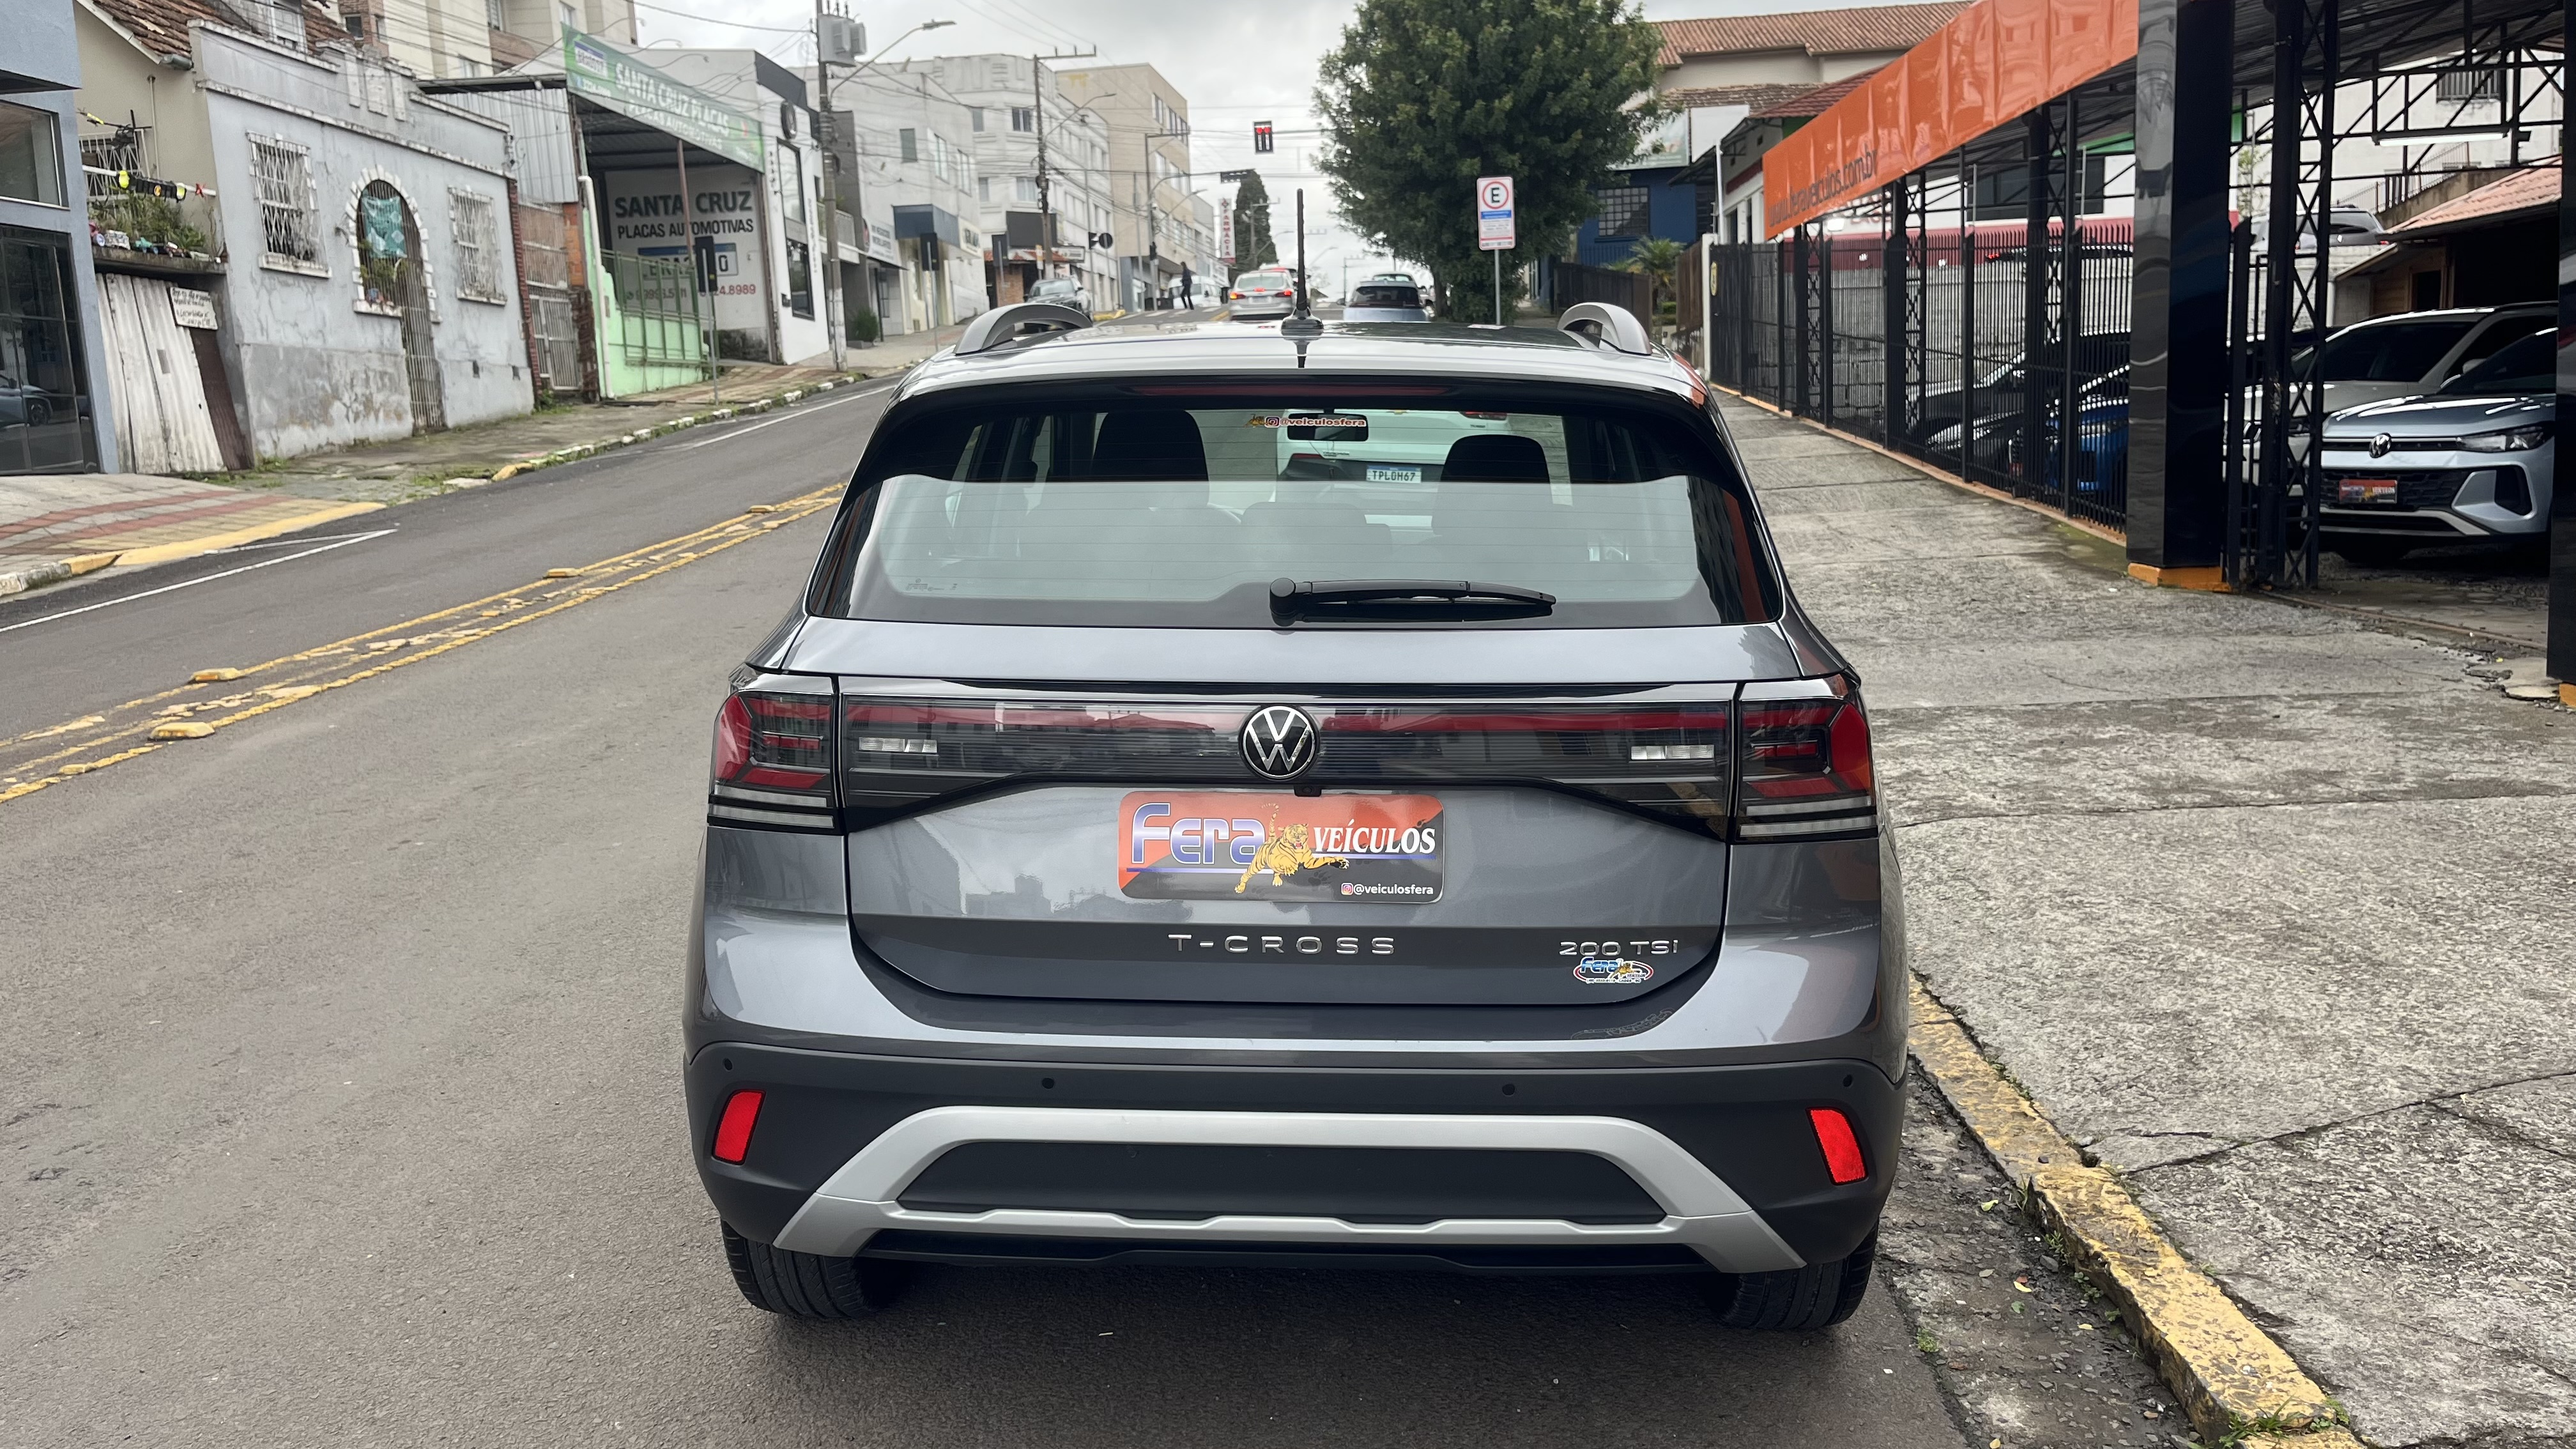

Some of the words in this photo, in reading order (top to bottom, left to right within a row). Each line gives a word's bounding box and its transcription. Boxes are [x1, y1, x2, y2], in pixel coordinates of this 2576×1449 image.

[615, 63, 656, 105] SANTA
[658, 82, 689, 117] CRUZ
[615, 194, 685, 218] SANTA
[695, 190, 753, 214] CRUZ
[1491, 187, 1500, 203] E
[618, 224, 665, 239] PLACAS
[669, 218, 754, 237] AUOMOTIVAS
[699, 284, 756, 297] 24.8989
[1280, 417, 1365, 427] @veiculosfera
[1313, 819, 1436, 854] VEÍCULOS
[1353, 883, 1434, 896] @veiculosfera
[1168, 934, 1395, 955] T-CROSS
[1559, 941, 1621, 956] 200
